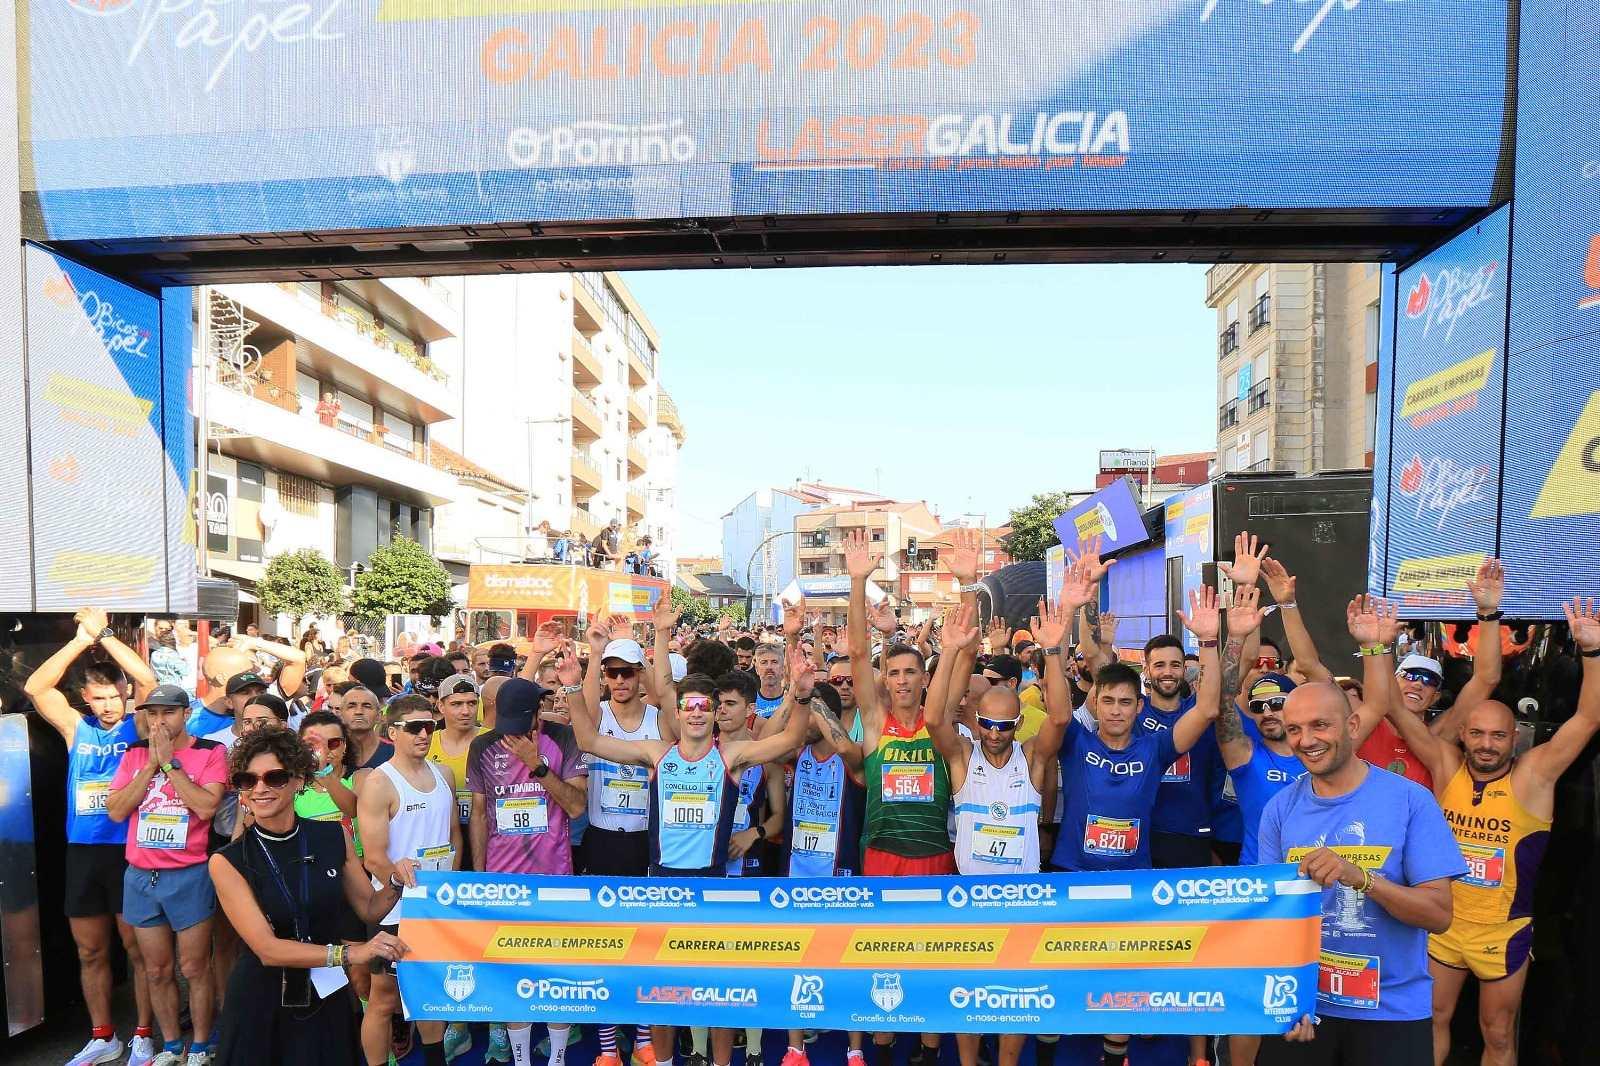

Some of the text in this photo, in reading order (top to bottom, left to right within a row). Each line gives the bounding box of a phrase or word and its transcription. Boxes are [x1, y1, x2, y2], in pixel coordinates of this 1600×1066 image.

[481, 10, 982, 84] GALICIA 2023
[665, 783, 698, 791] CONCELLO
[895, 779, 921, 795] 564
[406, 802, 427, 812] BMC
[618, 793, 631, 808] 21
[513, 813, 530, 828] 98
[674, 807, 704, 823] 1009
[146, 827, 175, 842] 1004
[804, 835, 819, 850] 117
[1100, 833, 1126, 849] 820
[1451, 829, 1509, 844] NTEAREAS
[989, 840, 1007, 857] 47
[457, 882, 531, 900] acero+
[618, 885, 695, 901] acero+
[791, 886, 873, 901] acero+
[970, 882, 1056, 900] acero+
[1176, 877, 1268, 896] acero+
